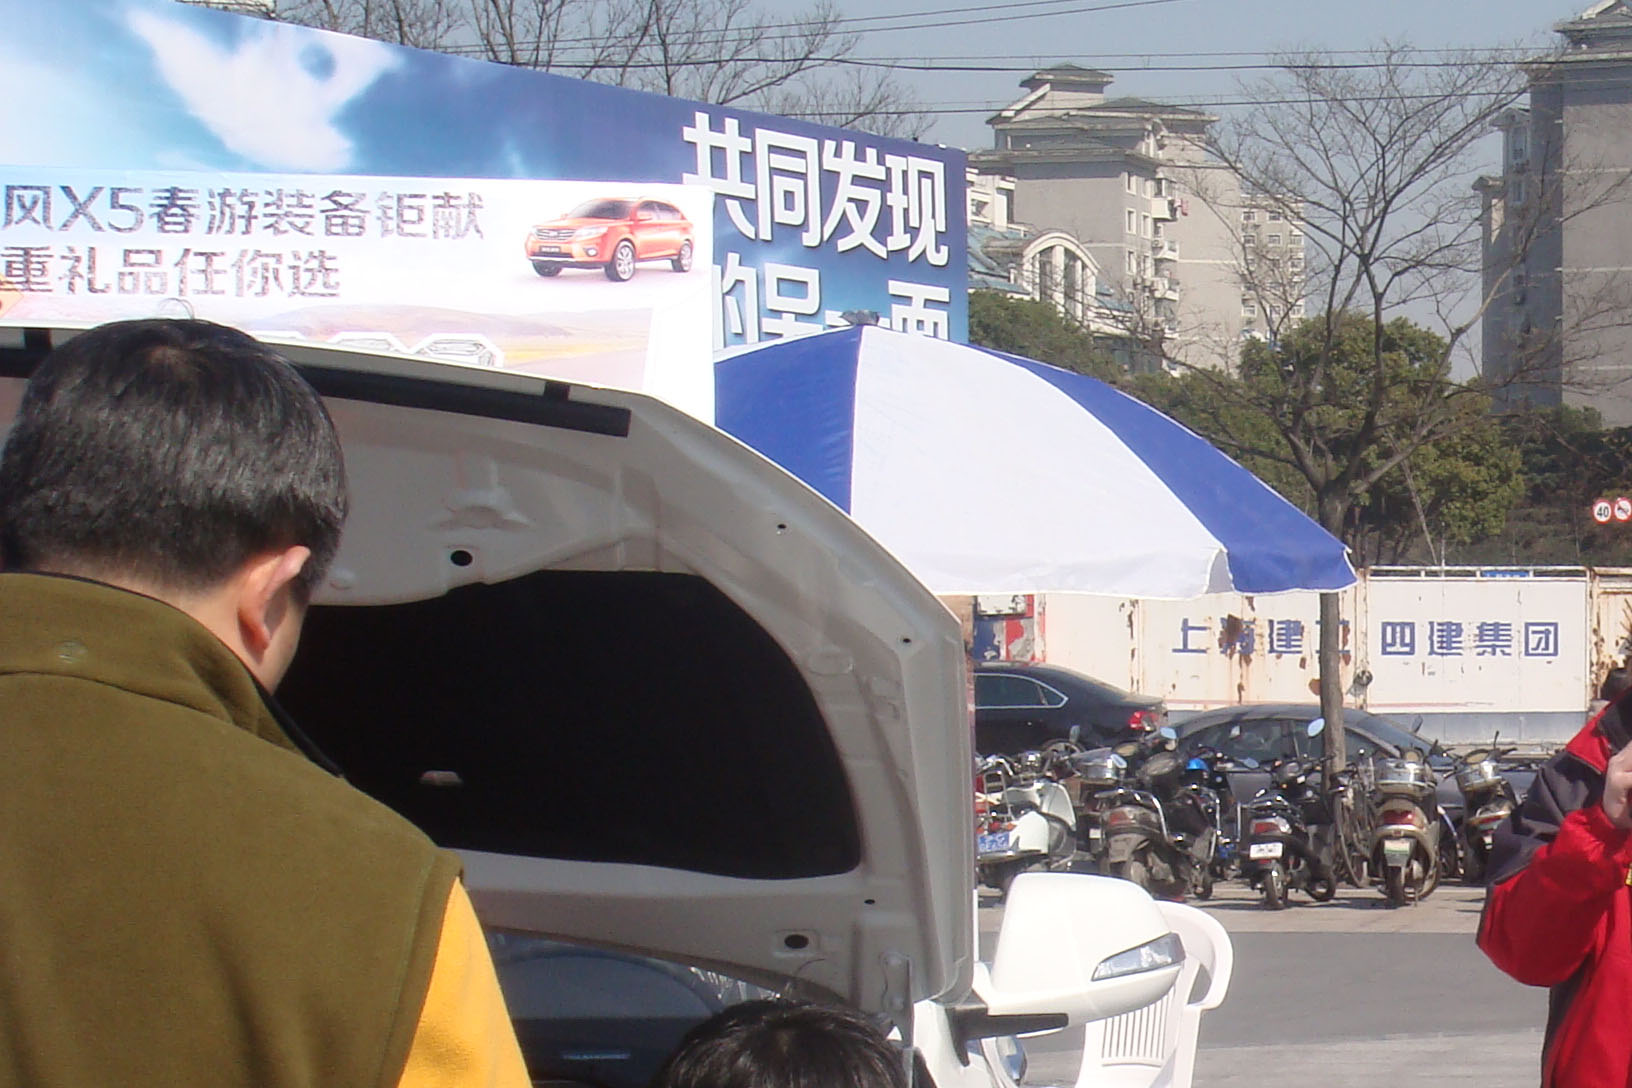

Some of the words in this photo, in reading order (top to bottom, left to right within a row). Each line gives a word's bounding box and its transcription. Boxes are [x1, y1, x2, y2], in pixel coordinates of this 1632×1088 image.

[682, 111, 949, 267] 共同发现
[0, 246, 341, 298] 重礼品任你选
[1597, 506, 1610, 518] 40
[1381, 621, 1559, 657] 四建集团
